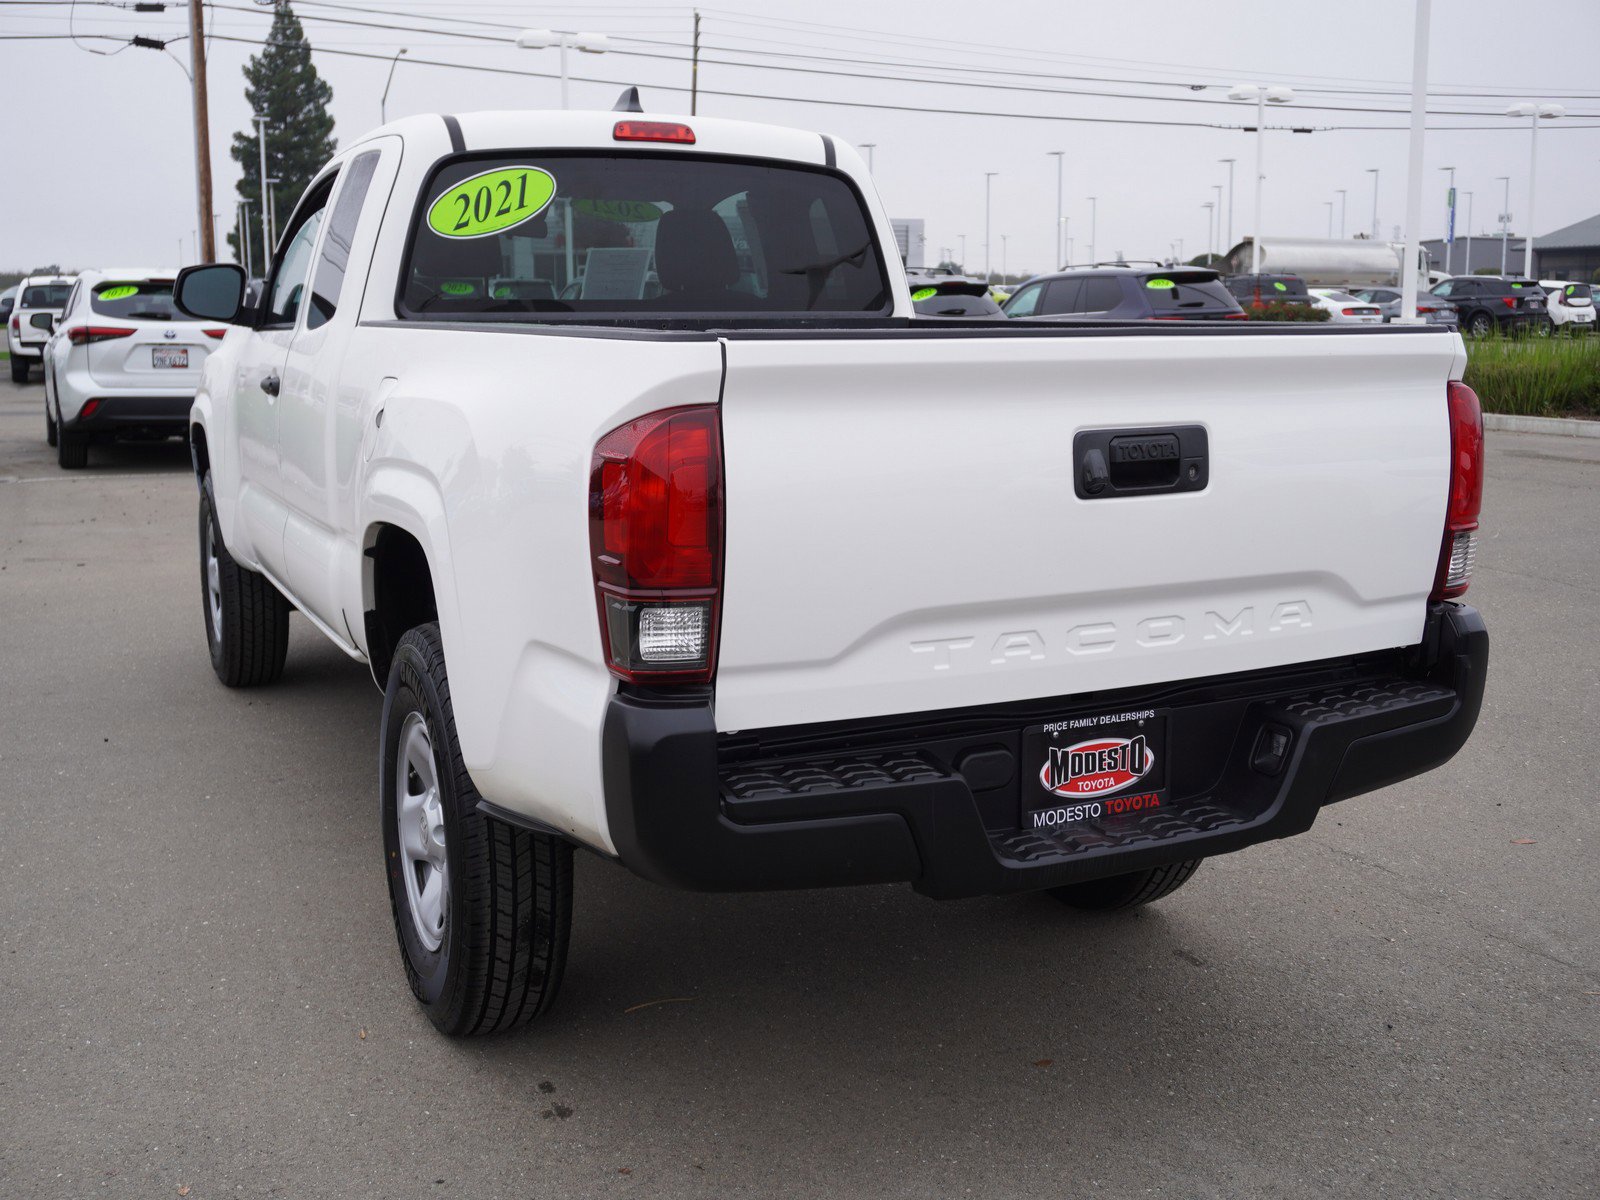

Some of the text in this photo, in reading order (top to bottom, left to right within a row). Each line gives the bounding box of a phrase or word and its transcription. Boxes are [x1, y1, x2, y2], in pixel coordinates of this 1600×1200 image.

[453, 173, 528, 231] 2021
[1118, 442, 1178, 460] TOYOTA
[910, 600, 1313, 670] TACOMA
[1043, 710, 1155, 733] PRICE FAMILY DEALERSHIPS
[1048, 735, 1146, 791] MODESTO
[1077, 777, 1116, 792] TOYOTA
[1033, 793, 1161, 828] MODESTO TOYOTA
